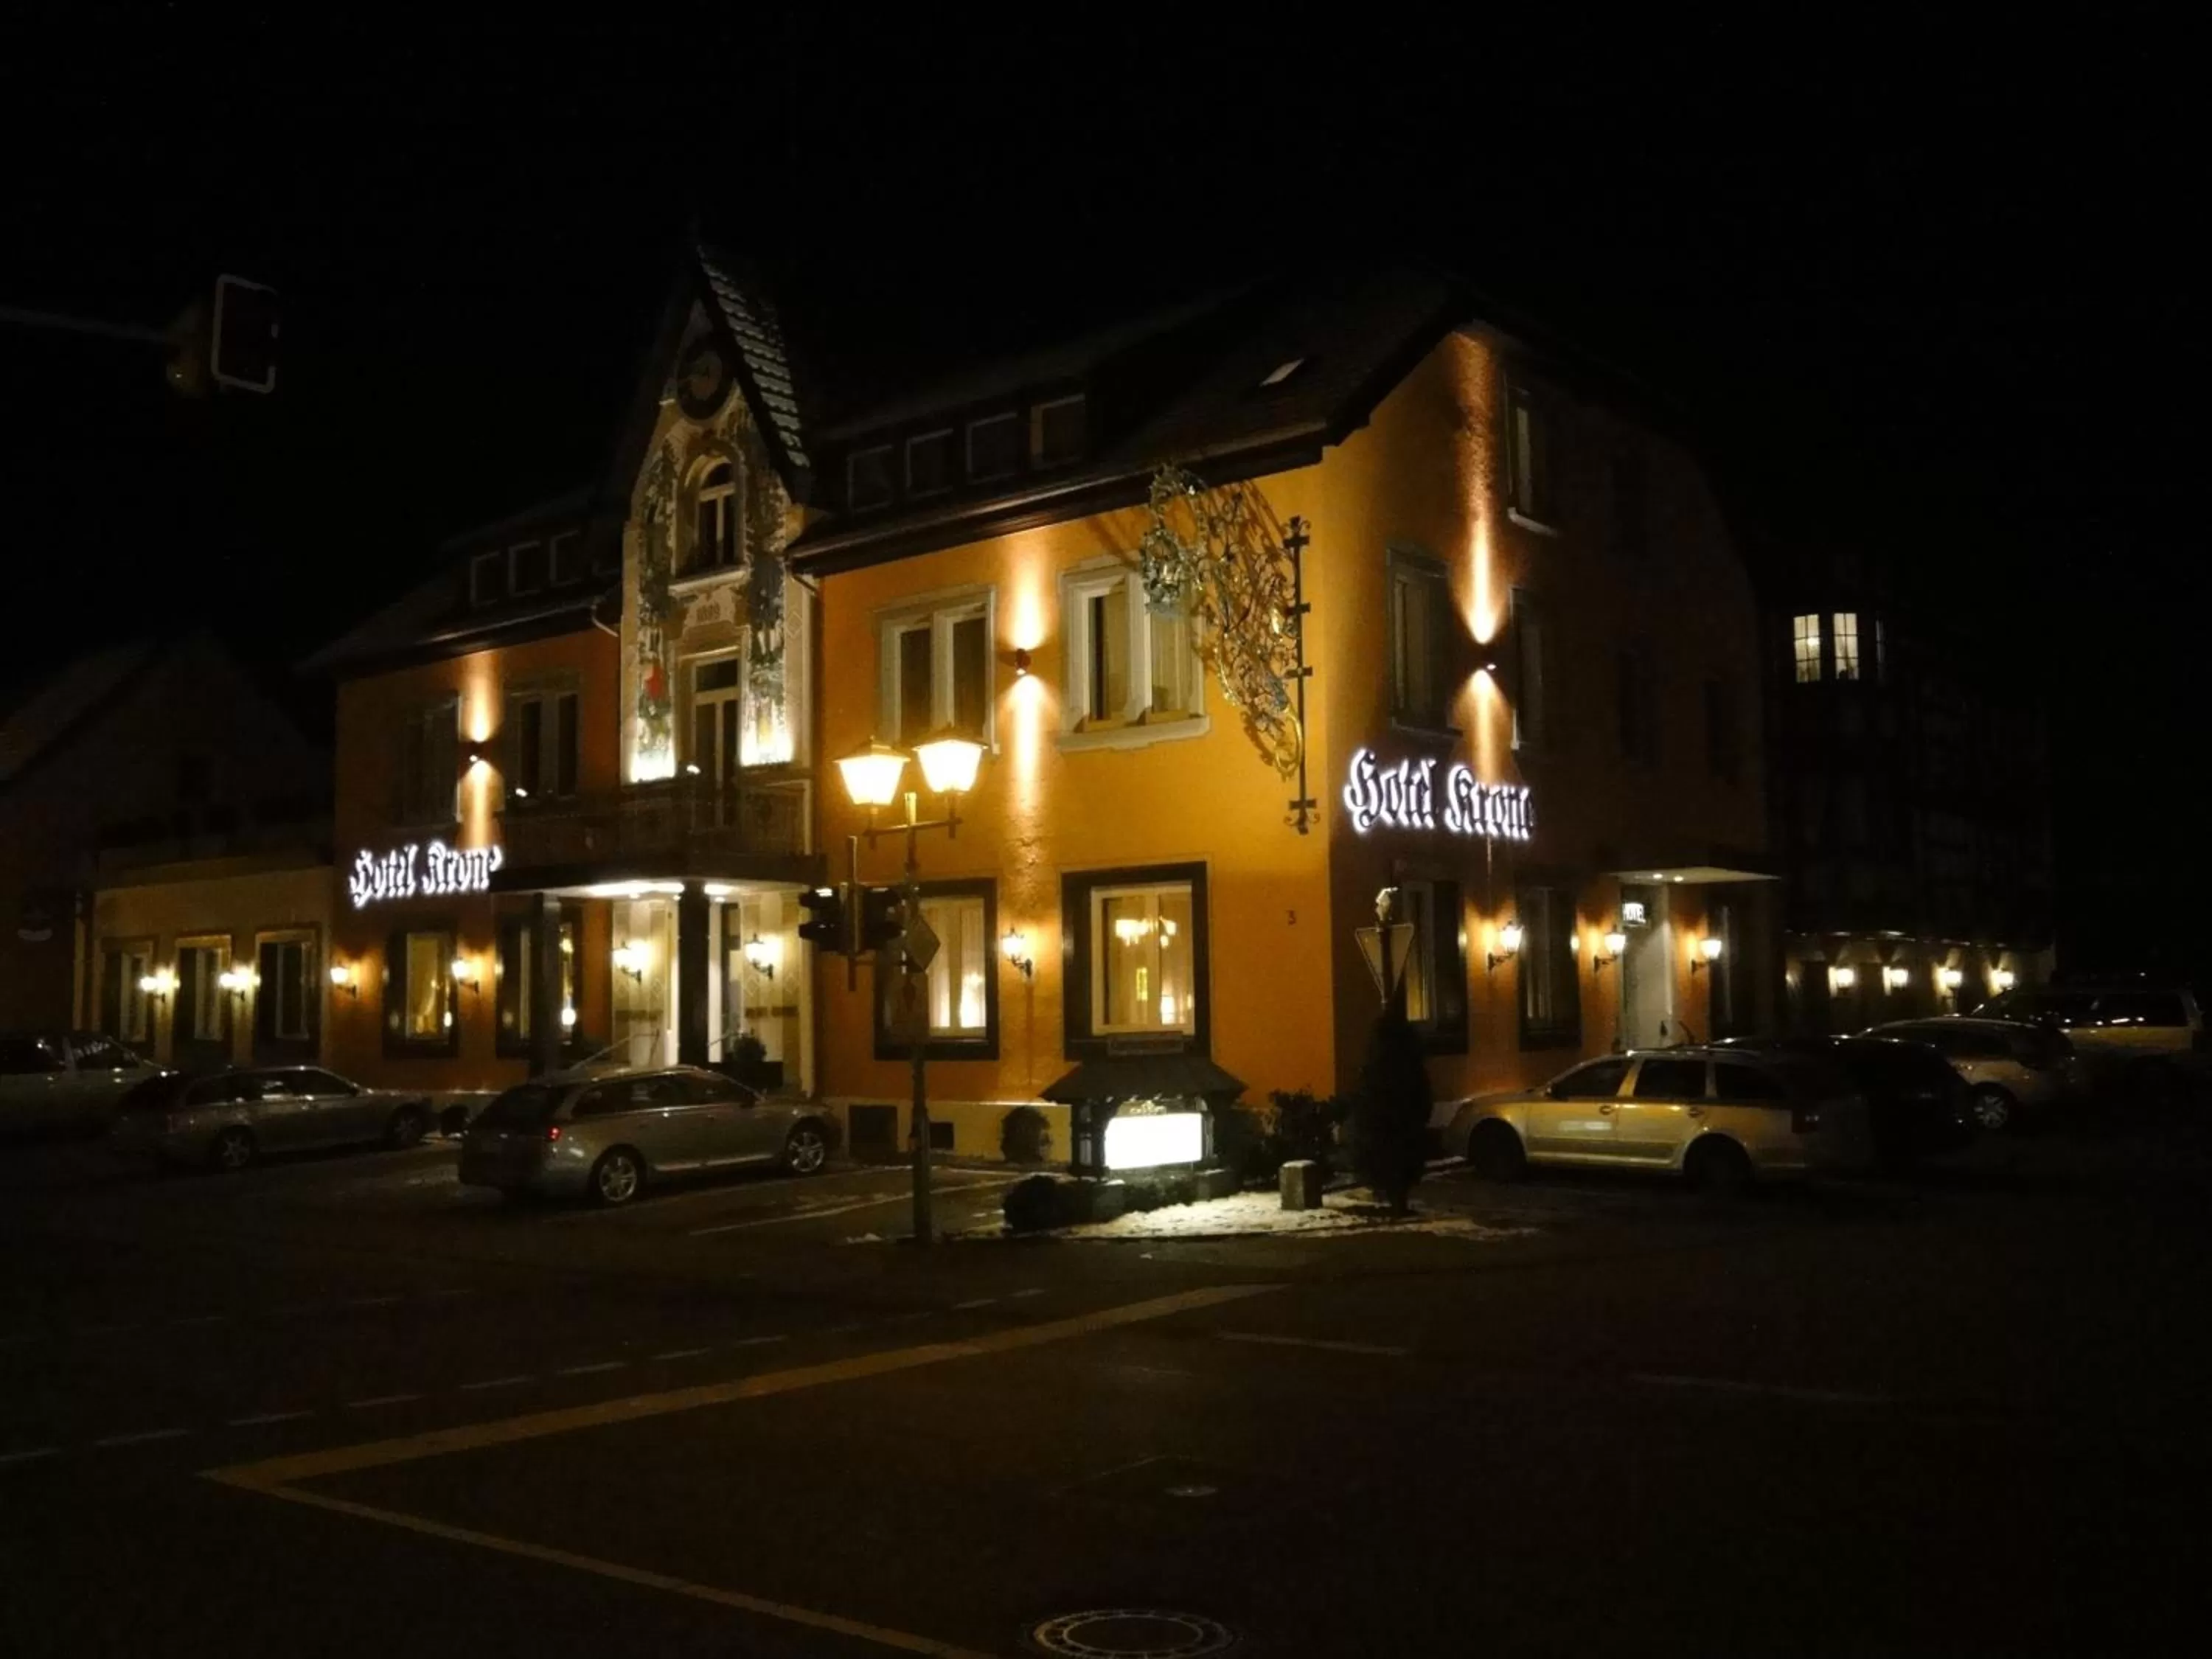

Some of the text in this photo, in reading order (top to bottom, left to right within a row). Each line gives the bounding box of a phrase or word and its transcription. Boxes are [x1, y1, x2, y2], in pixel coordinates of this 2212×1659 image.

[1343, 748, 1534, 841] Hotel Krone
[349, 845, 418, 908] Hotel
